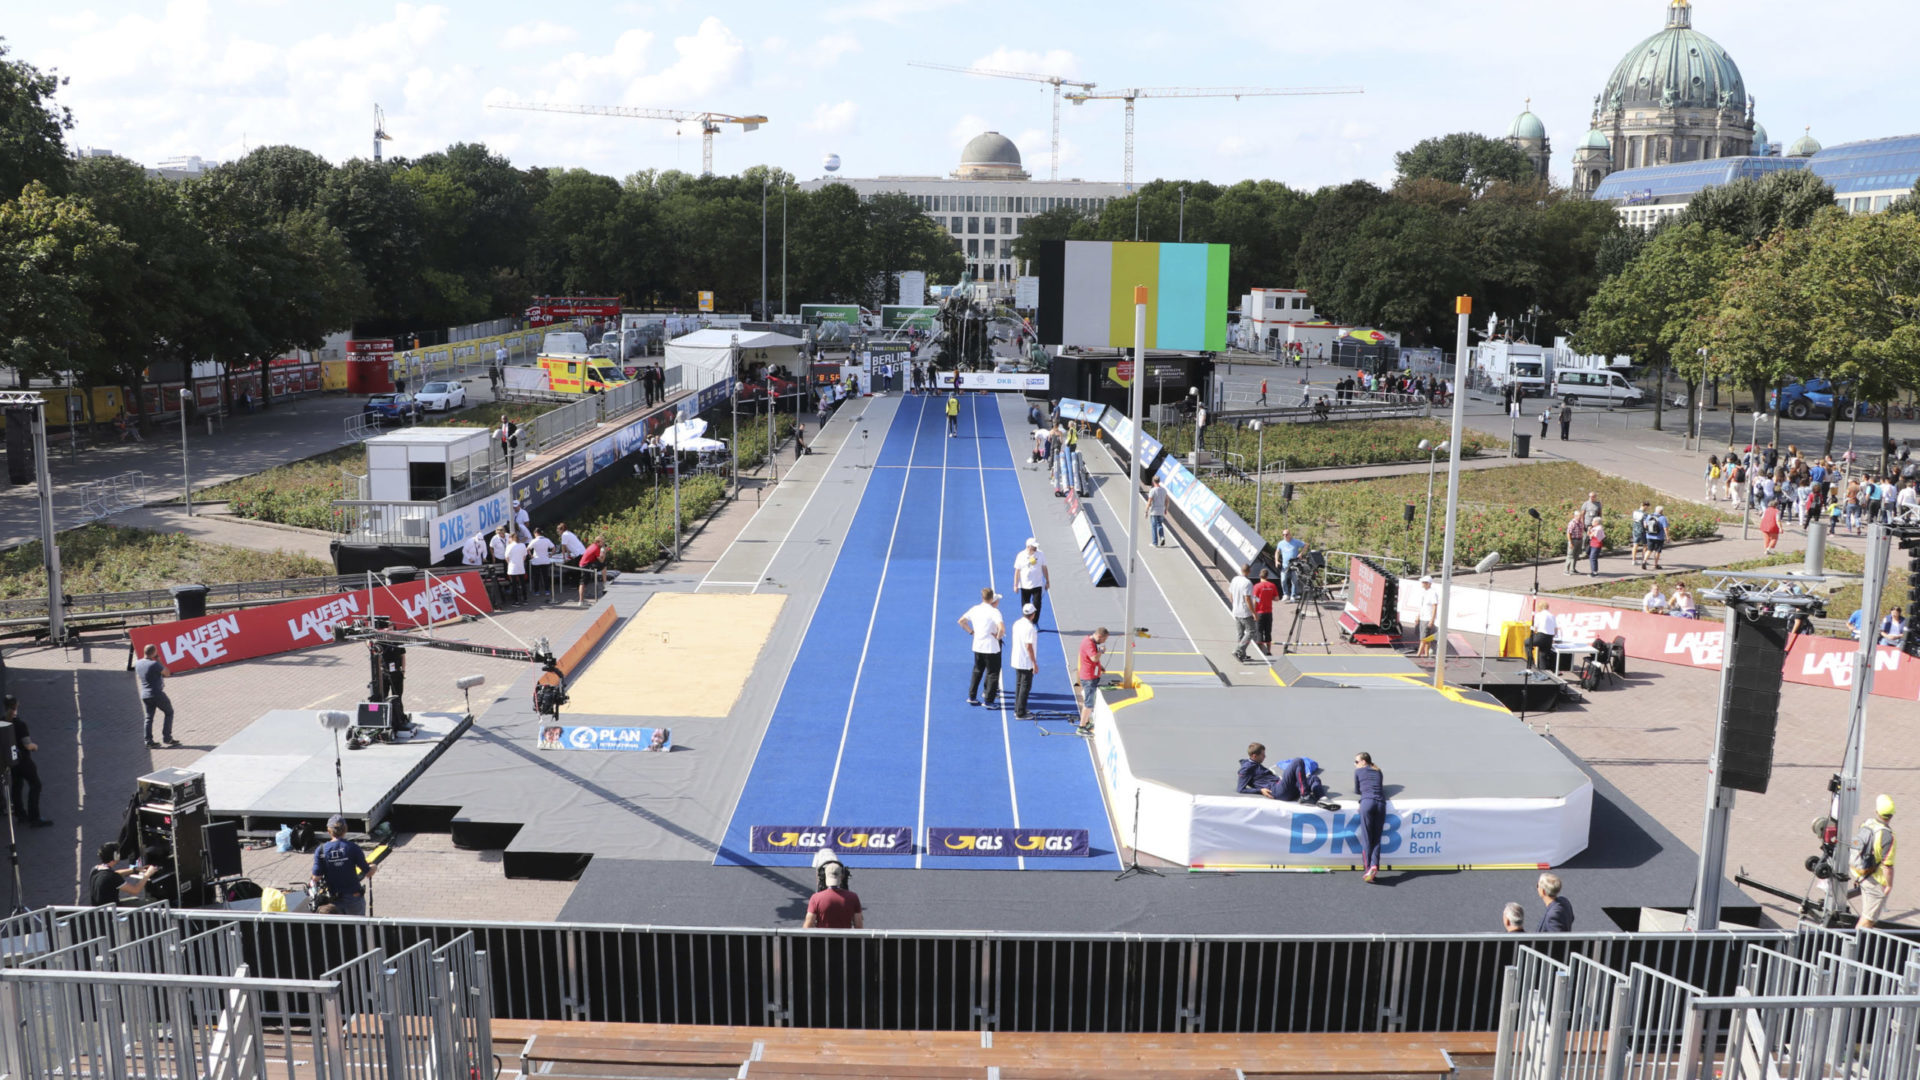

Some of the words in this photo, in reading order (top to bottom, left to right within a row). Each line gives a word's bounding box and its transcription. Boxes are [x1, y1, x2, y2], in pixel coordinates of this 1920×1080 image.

[815, 310, 846, 319] Europcar
[478, 499, 501, 530] DKB
[439, 515, 465, 549] DKB
[402, 576, 466, 619] LAUFEN
[288, 593, 359, 641] LAUFEN
[1555, 611, 1622, 641] AUFEN
[160, 614, 240, 665] LAUFEN
[193, 636, 228, 665] DE
[1831, 667, 1853, 686] D
[600, 729, 641, 742] PLAN
[1411, 812, 1436, 825] Das
[798, 832, 826, 847] GLS
[867, 833, 896, 848] GLS
[975, 835, 1003, 850] GLS
[1045, 836, 1073, 850] GLS
[1289, 812, 1403, 855] DKB
[1410, 829, 1442, 840] kann
[1409, 842, 1442, 854] Bank
